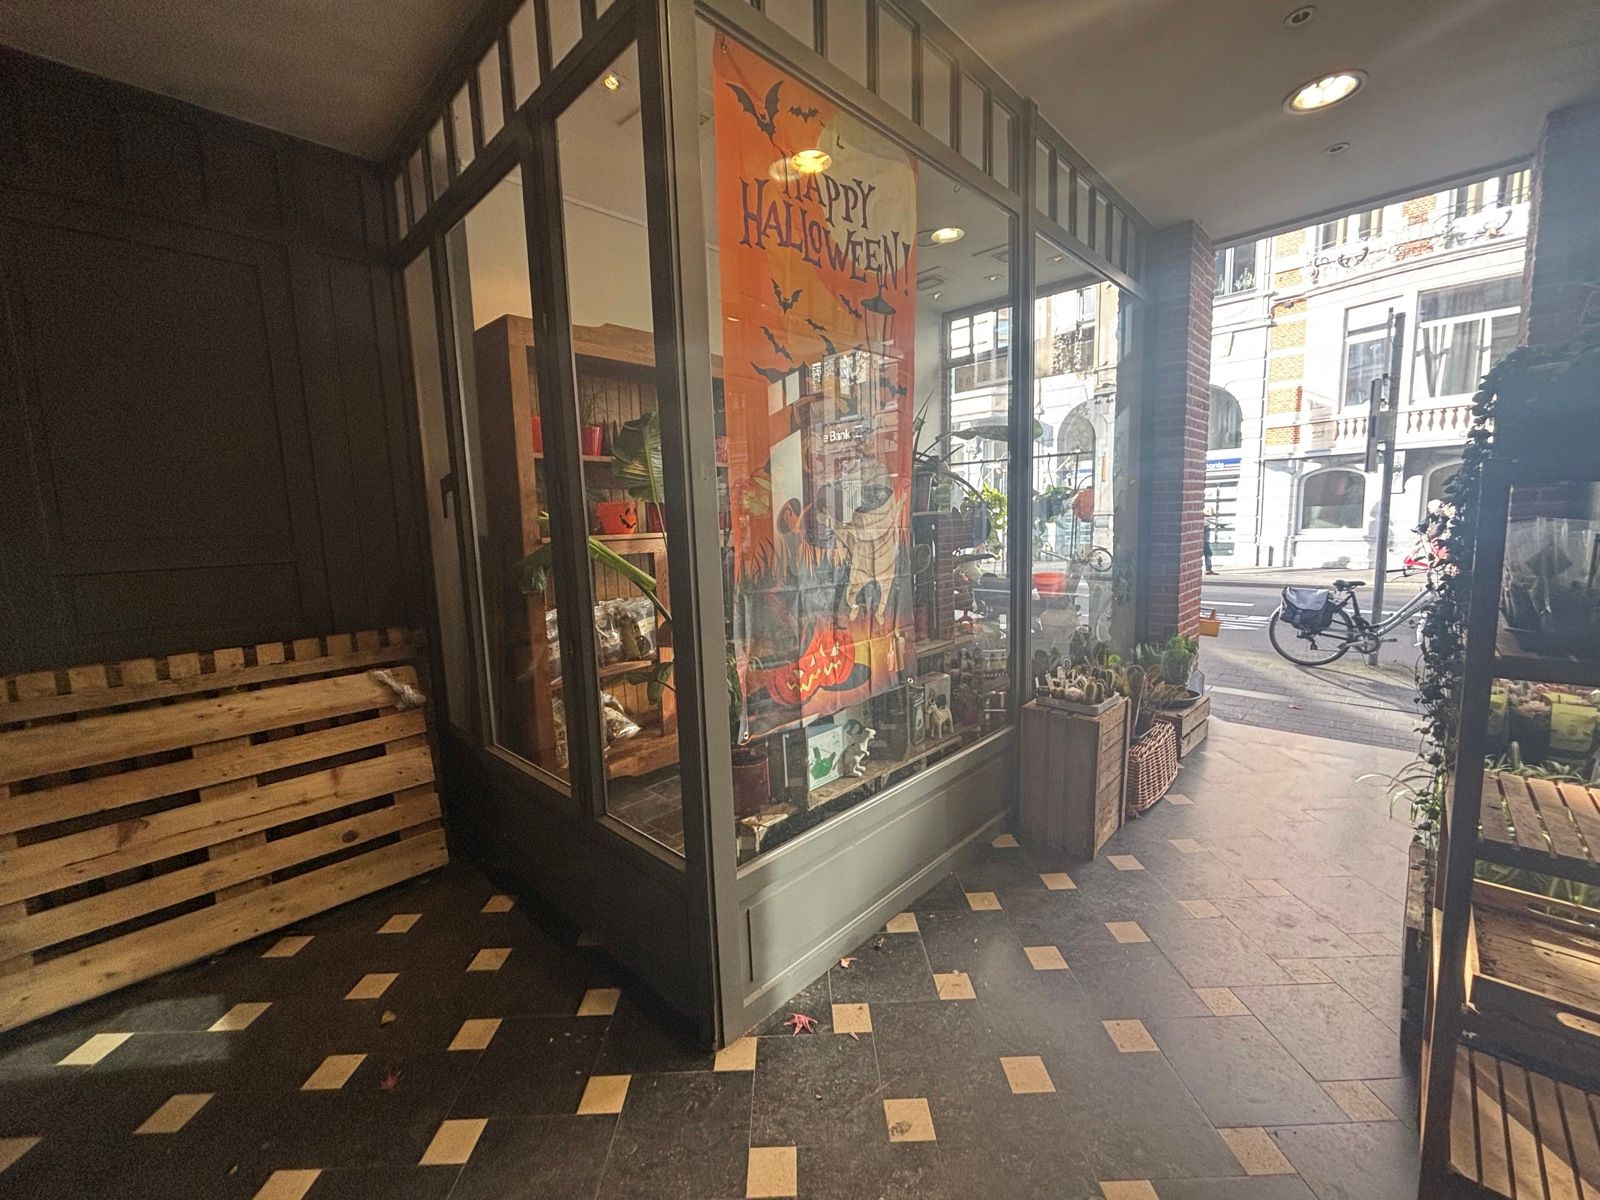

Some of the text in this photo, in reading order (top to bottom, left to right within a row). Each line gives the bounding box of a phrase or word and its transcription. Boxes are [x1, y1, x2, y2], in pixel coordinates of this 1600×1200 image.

[779, 148, 876, 229] HAPPY
[739, 176, 911, 296] HALLOWEEN!
[829, 428, 851, 442] Bank
